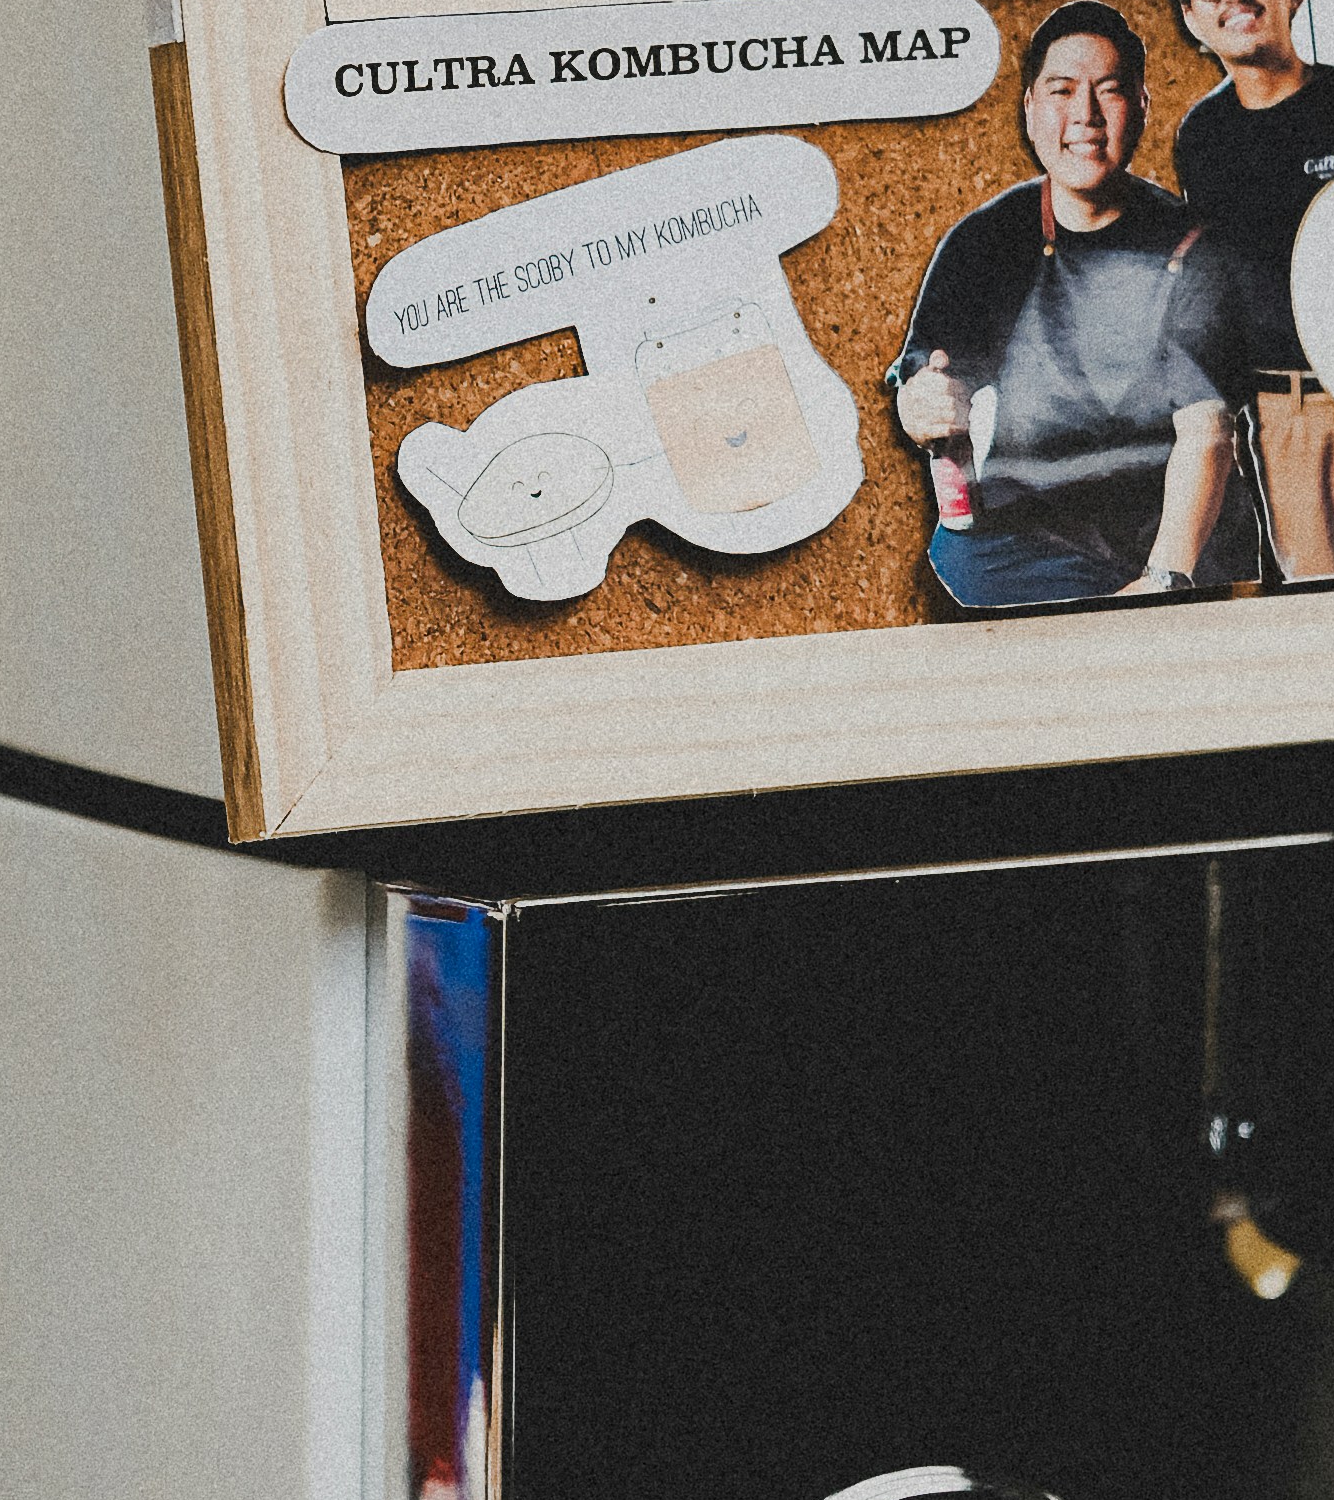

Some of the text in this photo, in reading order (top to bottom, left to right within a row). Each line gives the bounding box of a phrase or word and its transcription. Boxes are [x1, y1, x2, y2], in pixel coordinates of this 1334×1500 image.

[334, 26, 971, 98] CULTRA KOMBUCHA MAP
[393, 194, 763, 336] YOU ARE THE SCOBY TO MY KOMBUCHA
